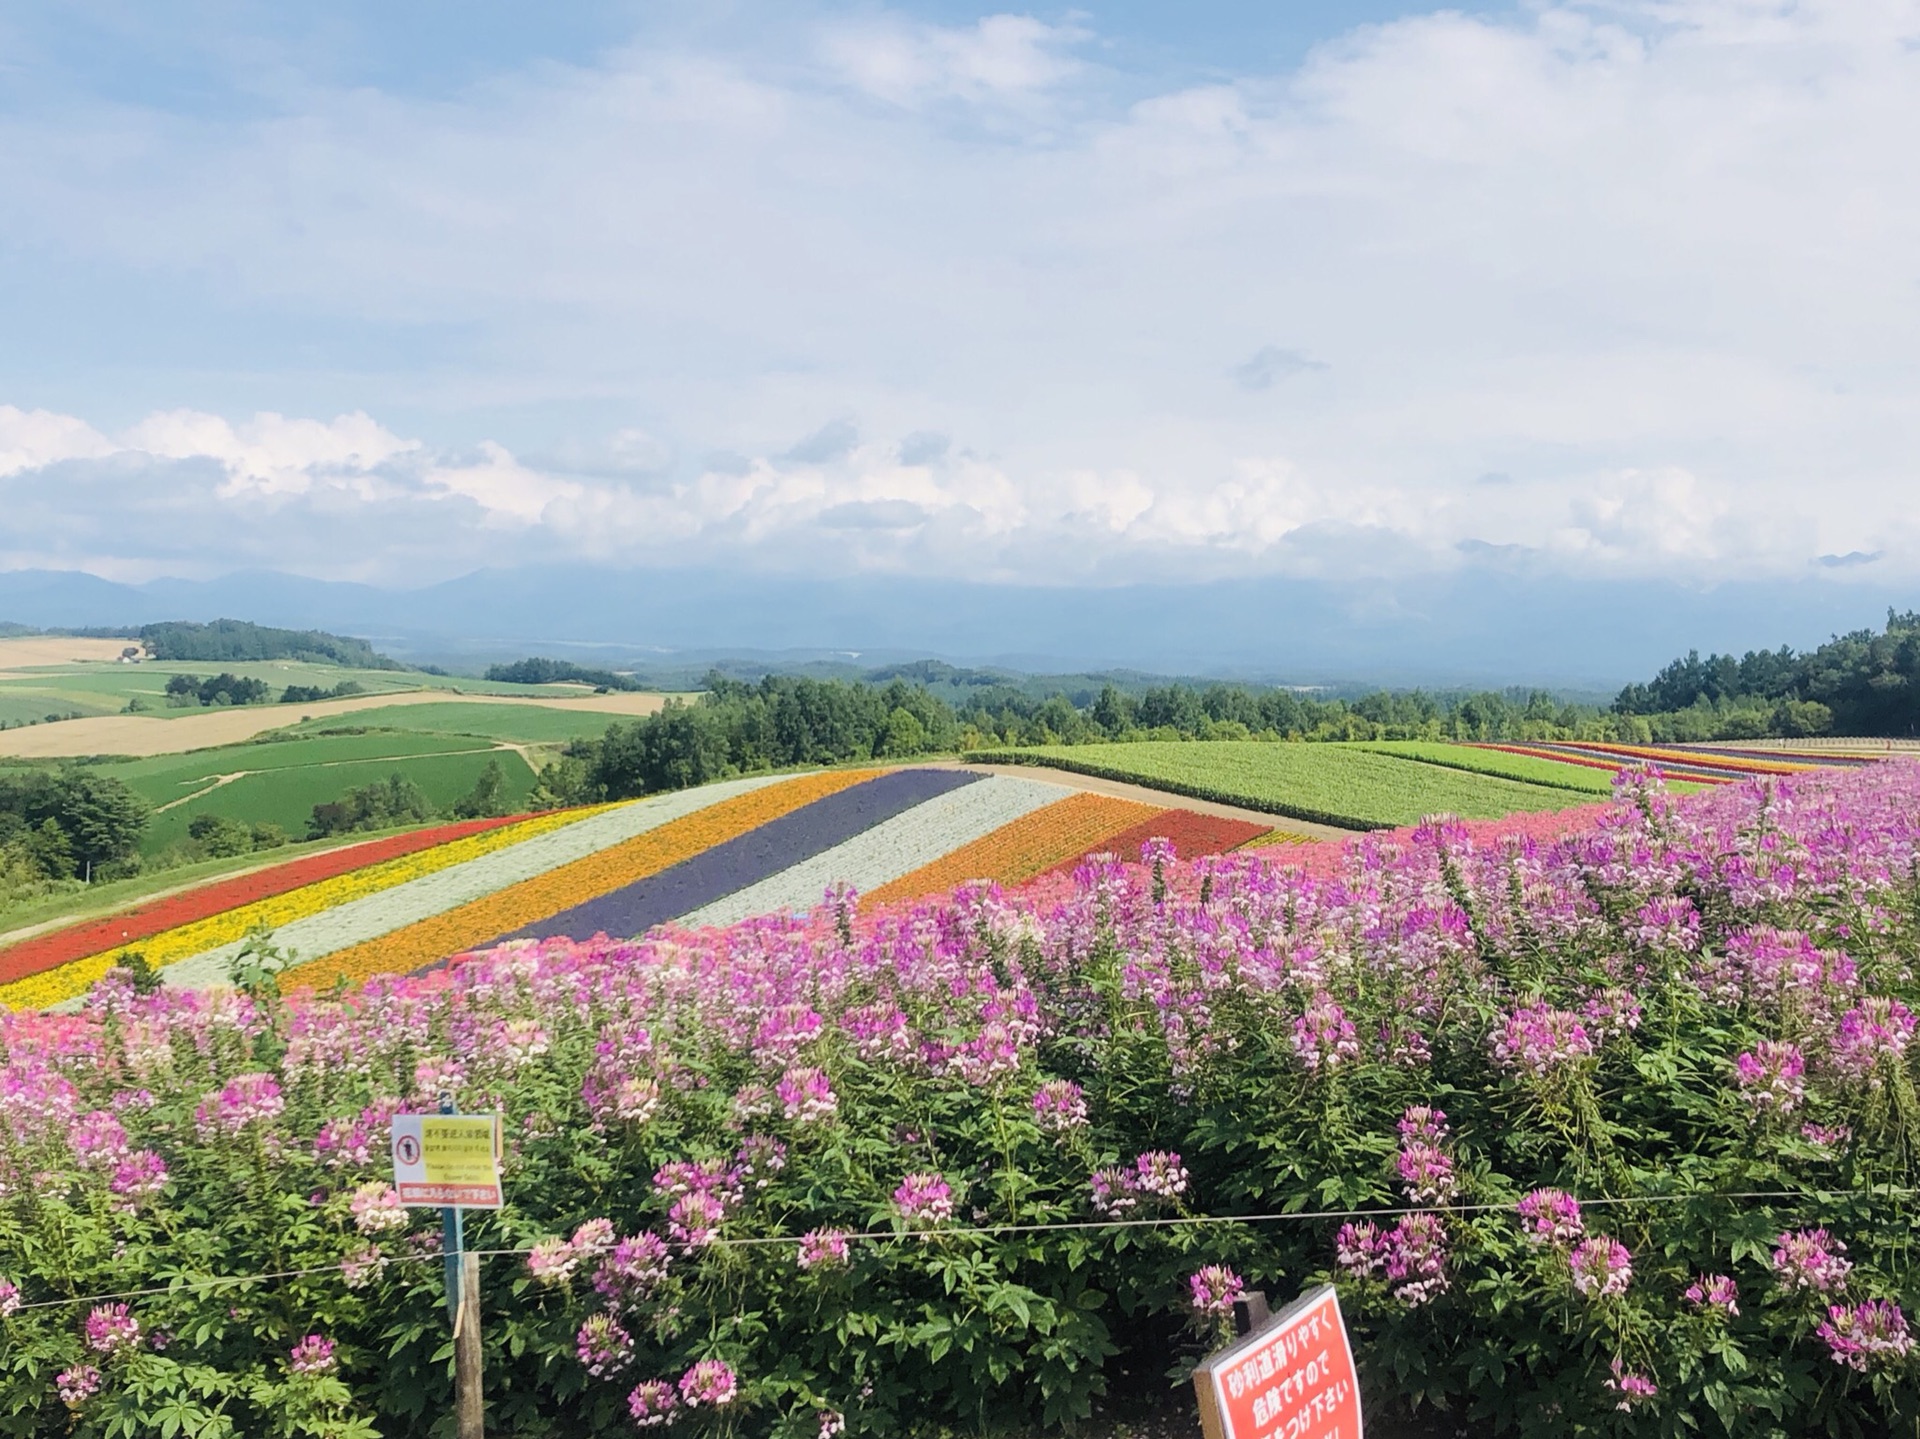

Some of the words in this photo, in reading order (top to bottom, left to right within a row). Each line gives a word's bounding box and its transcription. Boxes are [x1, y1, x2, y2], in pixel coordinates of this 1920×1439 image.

[1226, 1305, 1333, 1399] 砂利道滑りやすく
[1252, 1348, 1330, 1428] 危険ですので
[1260, 1378, 1349, 1439] をつけ下さい
